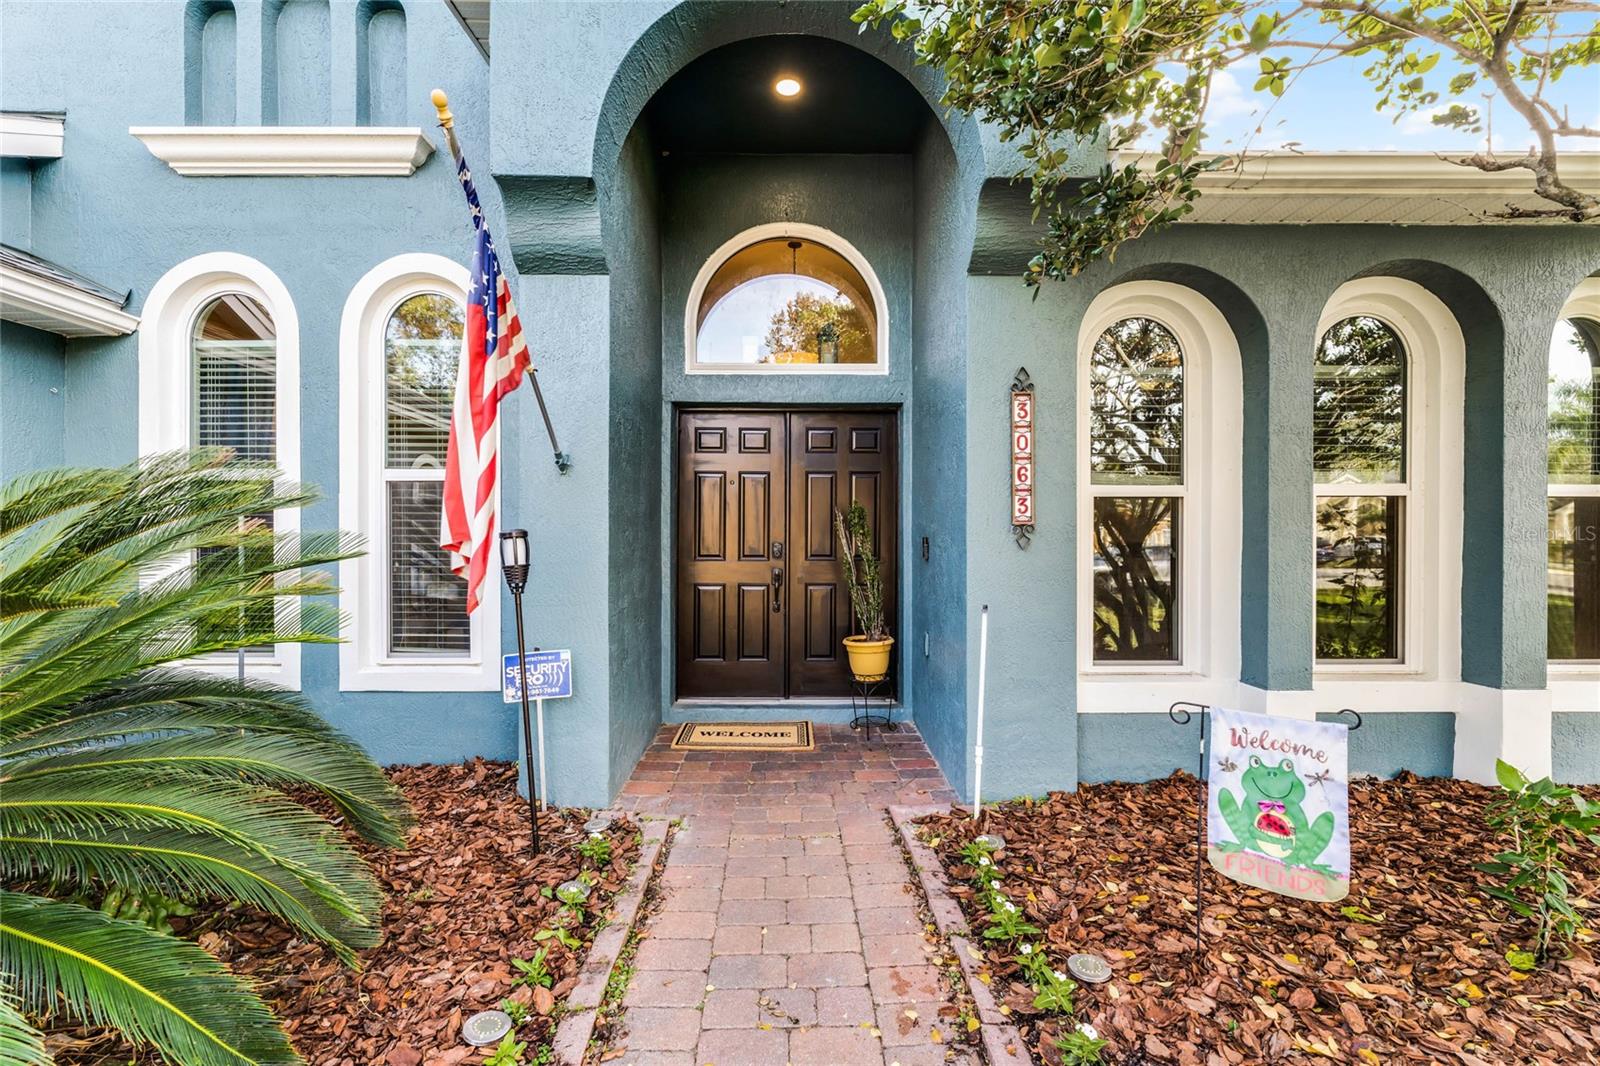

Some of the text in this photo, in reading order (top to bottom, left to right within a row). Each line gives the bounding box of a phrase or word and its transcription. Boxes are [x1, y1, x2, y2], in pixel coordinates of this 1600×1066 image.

[1016, 402, 1029, 515] 3063
[700, 730, 792, 738] WELCOME
[1229, 726, 1329, 765] Welcome
[1223, 853, 1328, 897] FRIENDS
